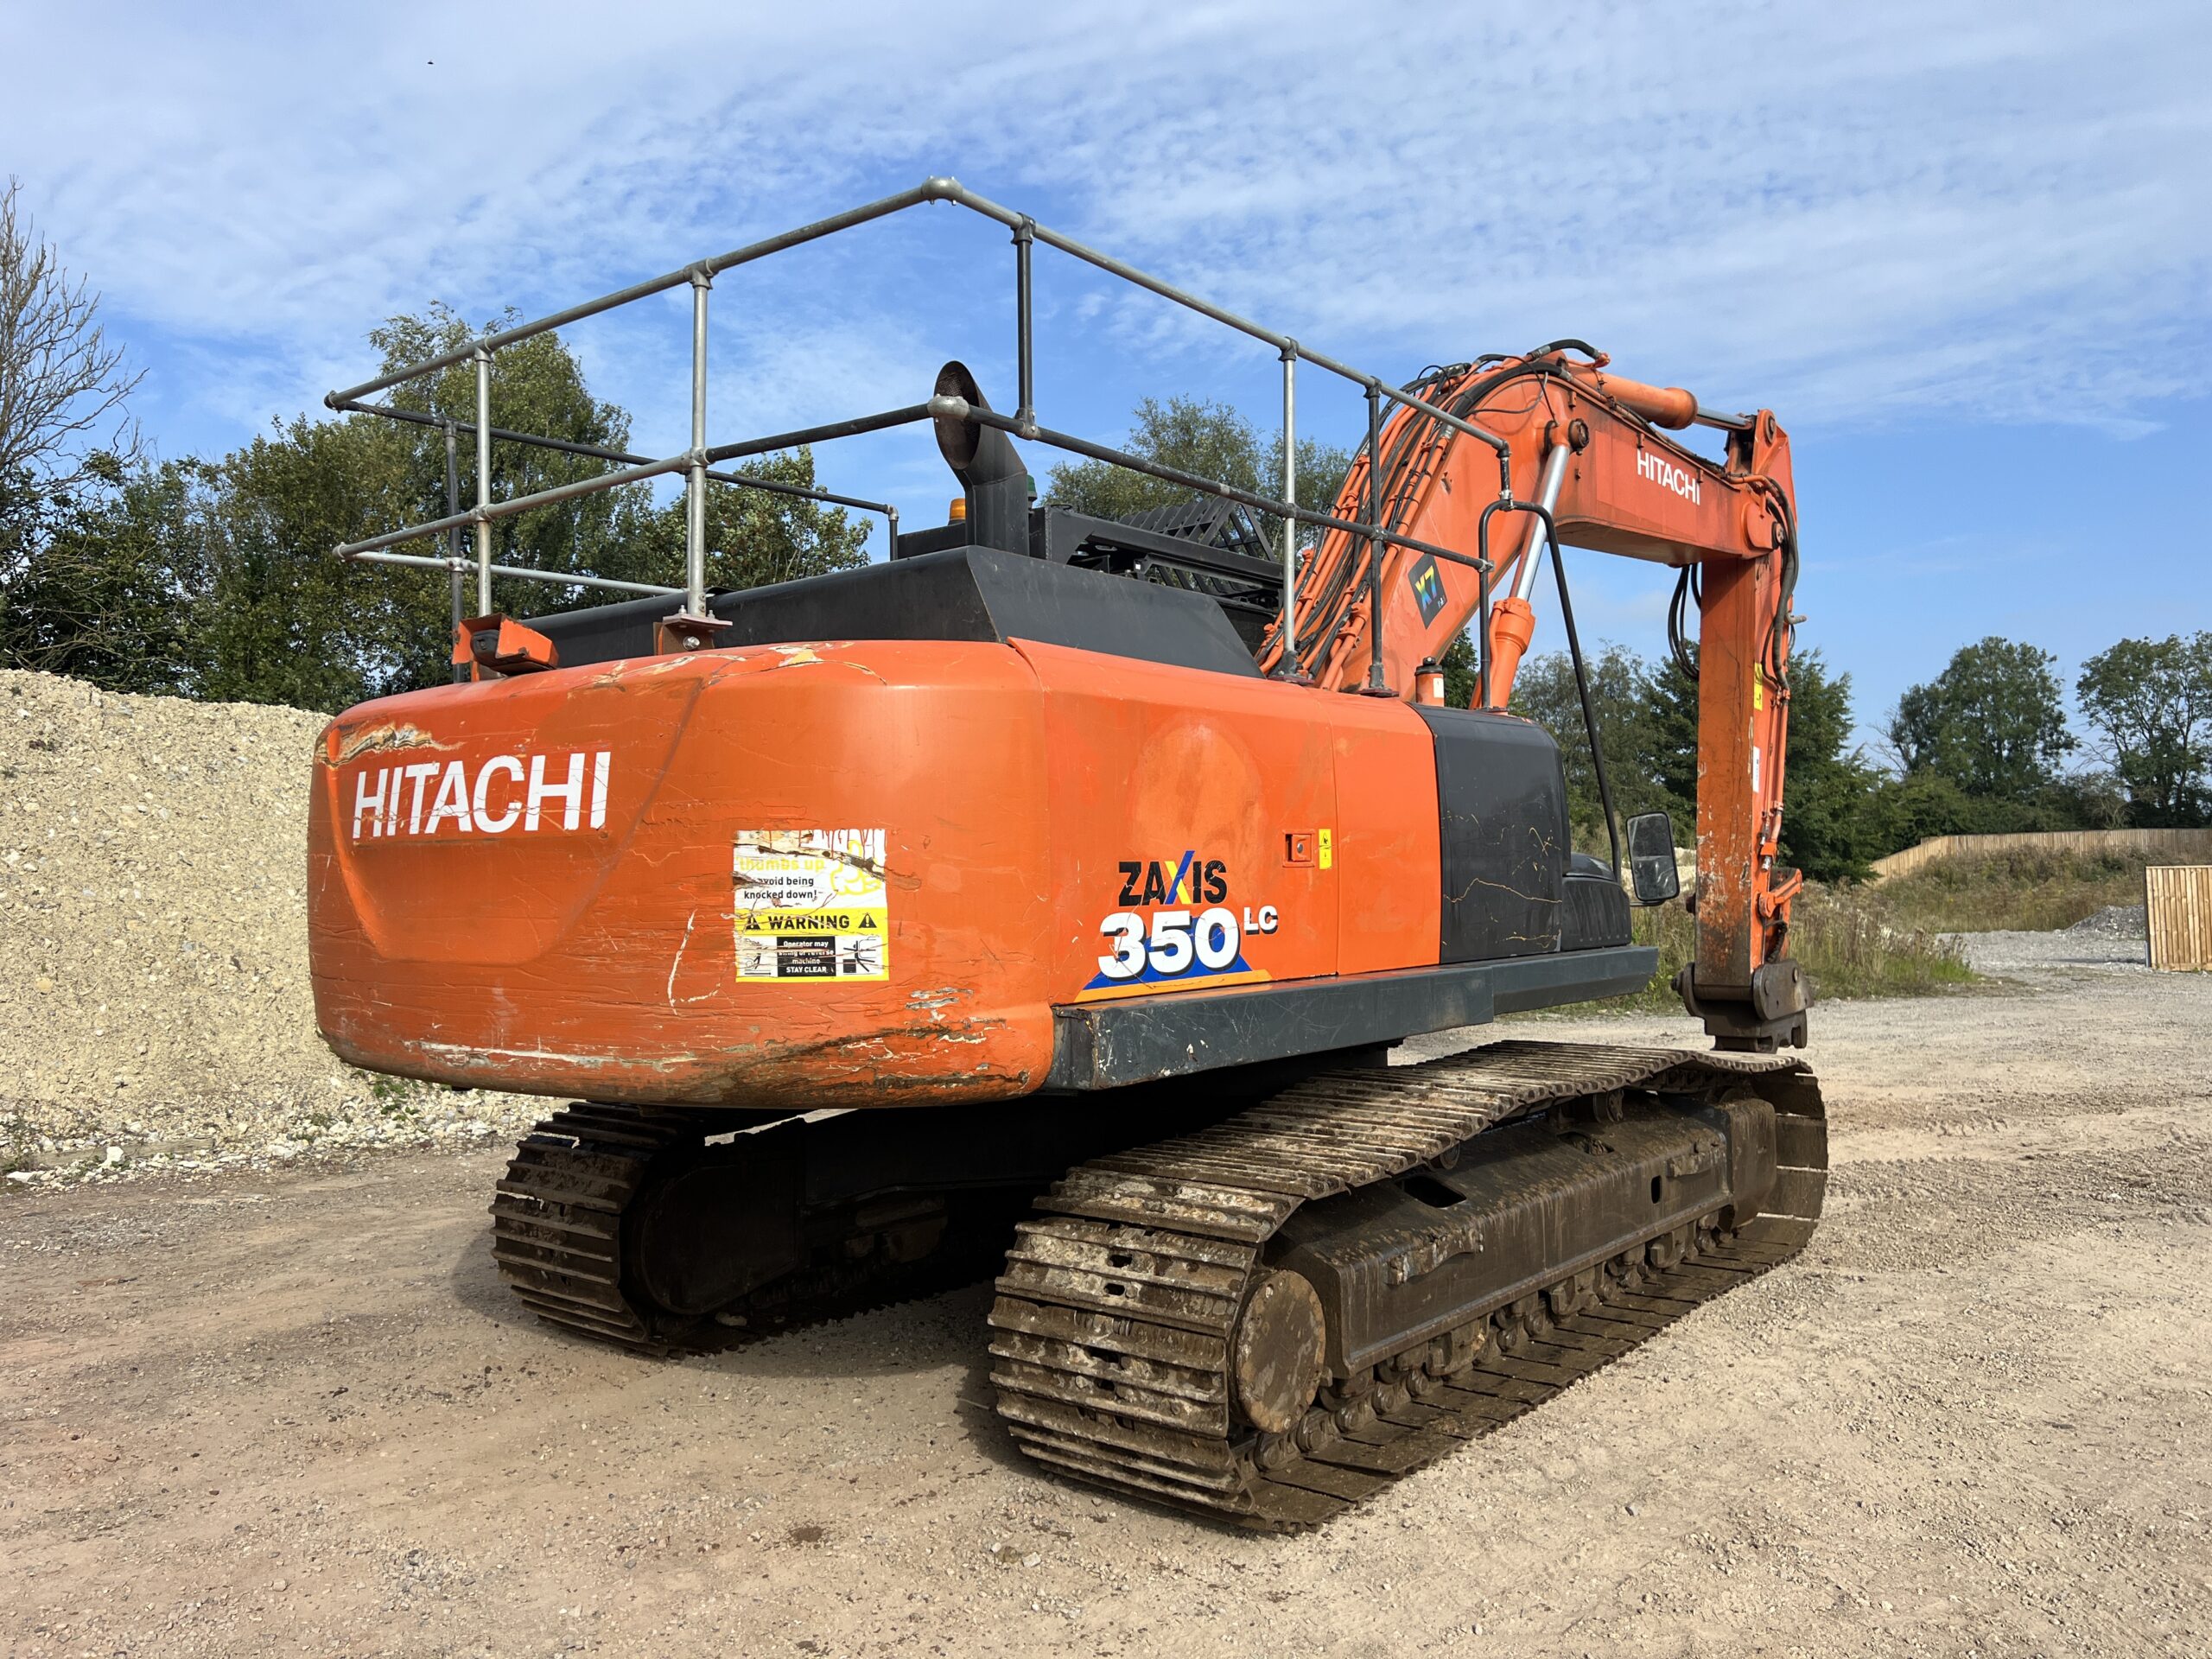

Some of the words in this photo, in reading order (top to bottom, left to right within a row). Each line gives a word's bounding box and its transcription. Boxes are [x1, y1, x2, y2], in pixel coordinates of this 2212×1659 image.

[1637, 448, 1700, 505] HITACHI
[1414, 565, 1437, 613] X7
[352, 751, 611, 839] HITACHI
[744, 890, 784, 899] knocked
[786, 889, 817, 899] down!
[786, 876, 814, 887] being
[1118, 850, 1228, 907] ZAXIS
[768, 915, 849, 930] WARNING
[1098, 906, 1242, 982] 350
[1243, 906, 1279, 935] LC
